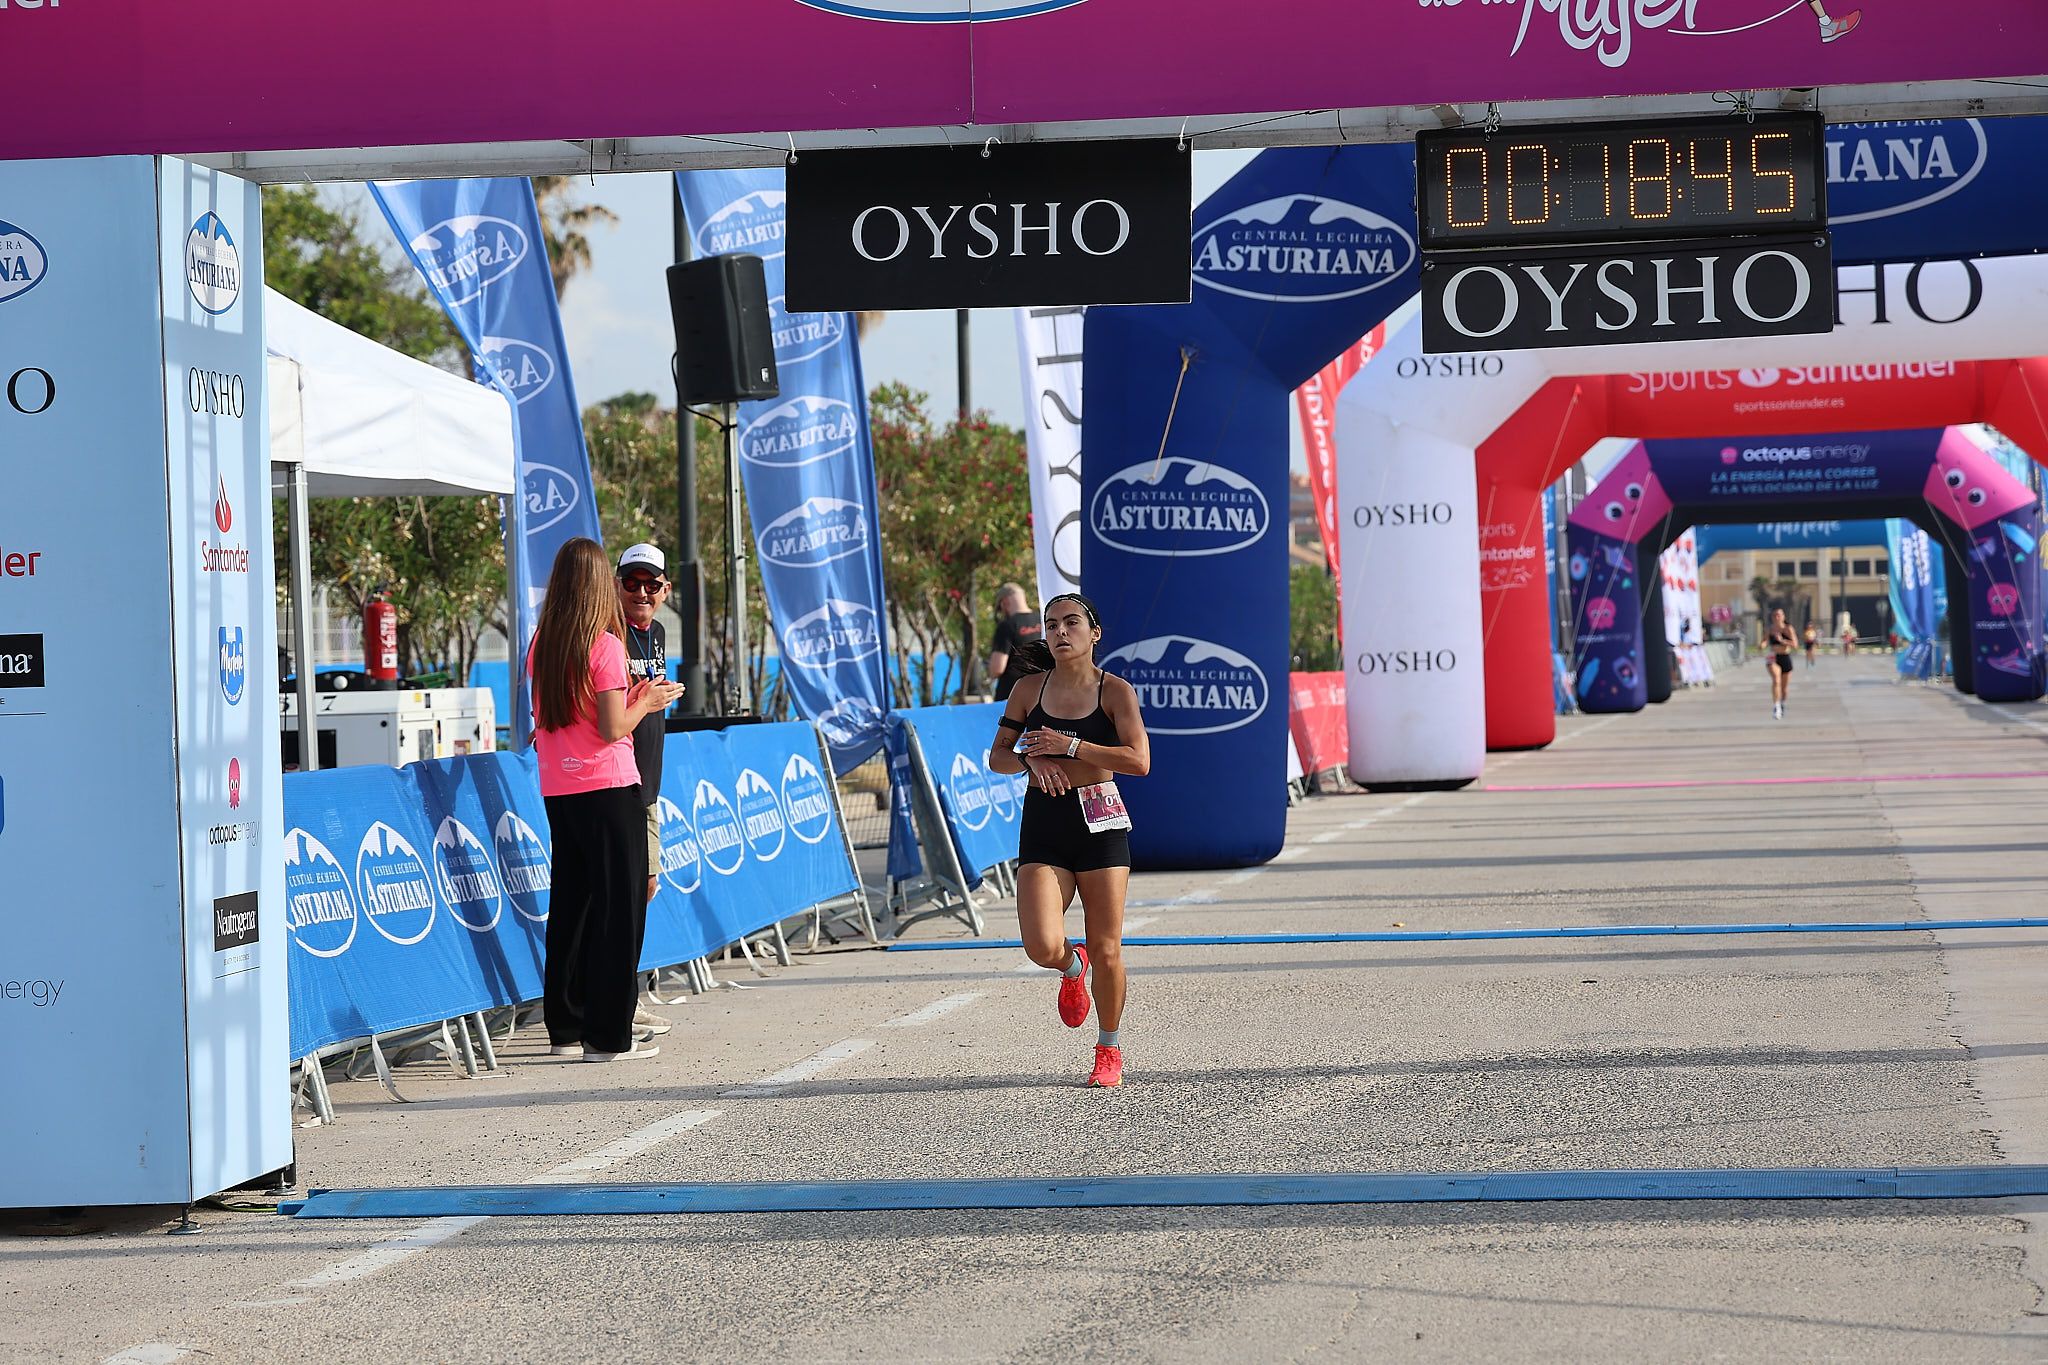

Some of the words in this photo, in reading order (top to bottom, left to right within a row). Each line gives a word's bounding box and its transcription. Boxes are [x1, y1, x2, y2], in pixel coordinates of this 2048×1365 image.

[1446, 133, 1795, 229] 00:18:45
[851, 199, 1131, 262] OYSHO
[1232, 230, 1308, 242] CENTRAL
[1315, 231, 1393, 244] LECHERA
[190, 244, 236, 292] ASTURIANA
[1192, 234, 1396, 275] ASTURIANA
[1442, 250, 1811, 338] OYSHO
[1397, 355, 1504, 379] OYSHO
[188, 366, 245, 419] OYSHO
[1733, 396, 1845, 414] sportssantander.es
[1099, 494, 1259, 533] ASTURIANA
[1122, 491, 1184, 501] CENTRAL
[1191, 491, 1253, 503] LECHERA
[1353, 502, 1452, 528] OYSHO
[201, 540, 249, 573] Santander
[1121, 669, 1184, 680] CENTRAL
[1190, 670, 1253, 682] LECHERA
[1357, 649, 1456, 675] OYSHO
[1136, 683, 1258, 711] TURIANA
[364, 869, 432, 916] ASTURIANA
[439, 860, 499, 905] ASTURIANA
[216, 909, 256, 941] Neutrogena
